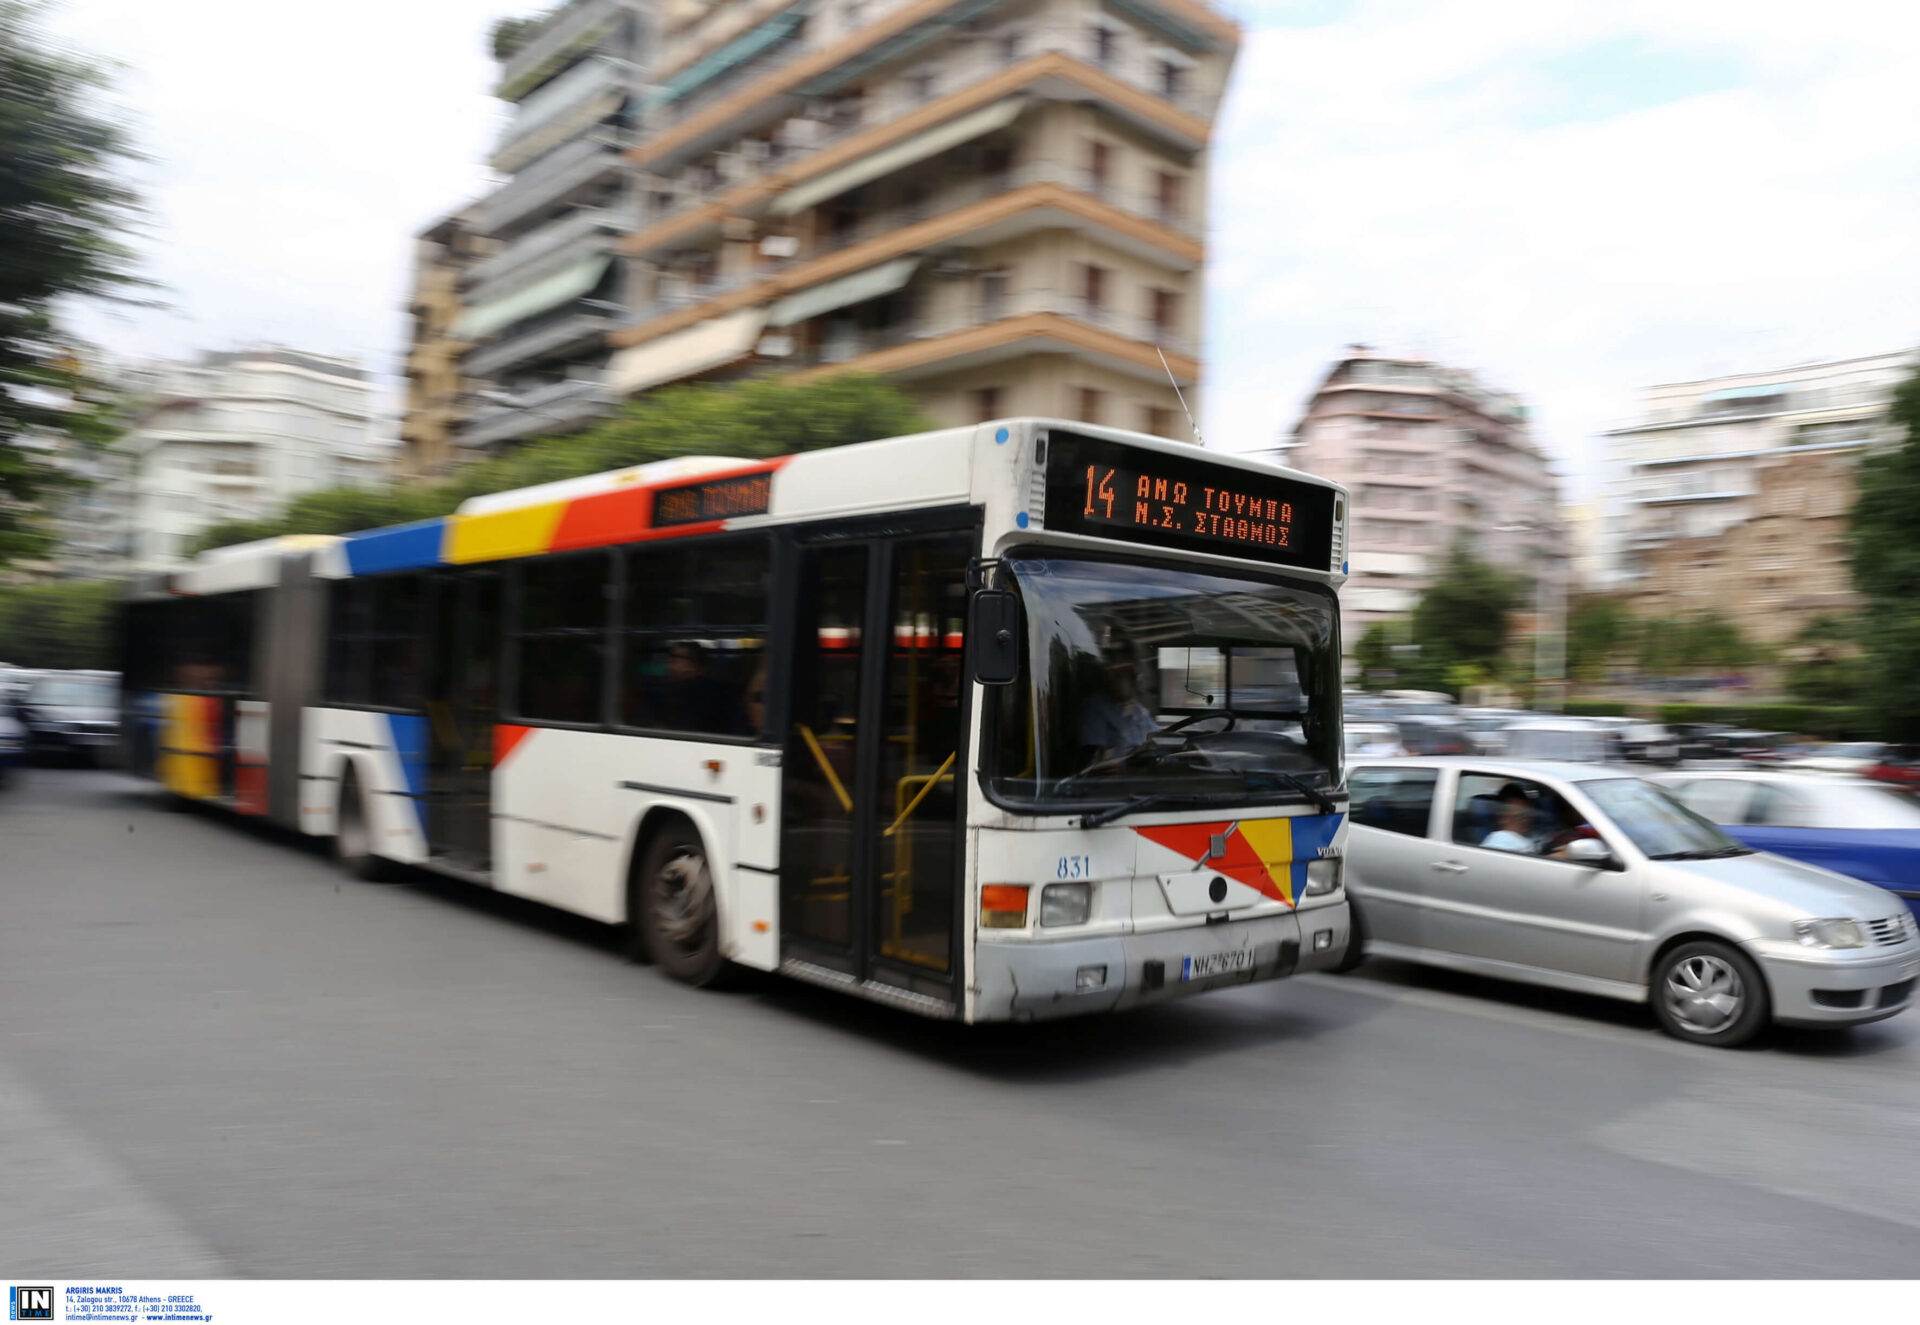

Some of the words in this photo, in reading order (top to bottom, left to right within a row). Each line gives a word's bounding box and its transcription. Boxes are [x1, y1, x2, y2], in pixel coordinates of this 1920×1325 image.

[1084, 465, 1115, 518] 14
[1137, 475, 1187, 505] ΑΝΩ
[1204, 488, 1292, 523] ΤΟΥΜΠΑ
[1135, 501, 1182, 529] Ν.Σ.
[1195, 512, 1290, 547] ΣΤΑΘΜΟΣ
[1057, 855, 1089, 880] 831
